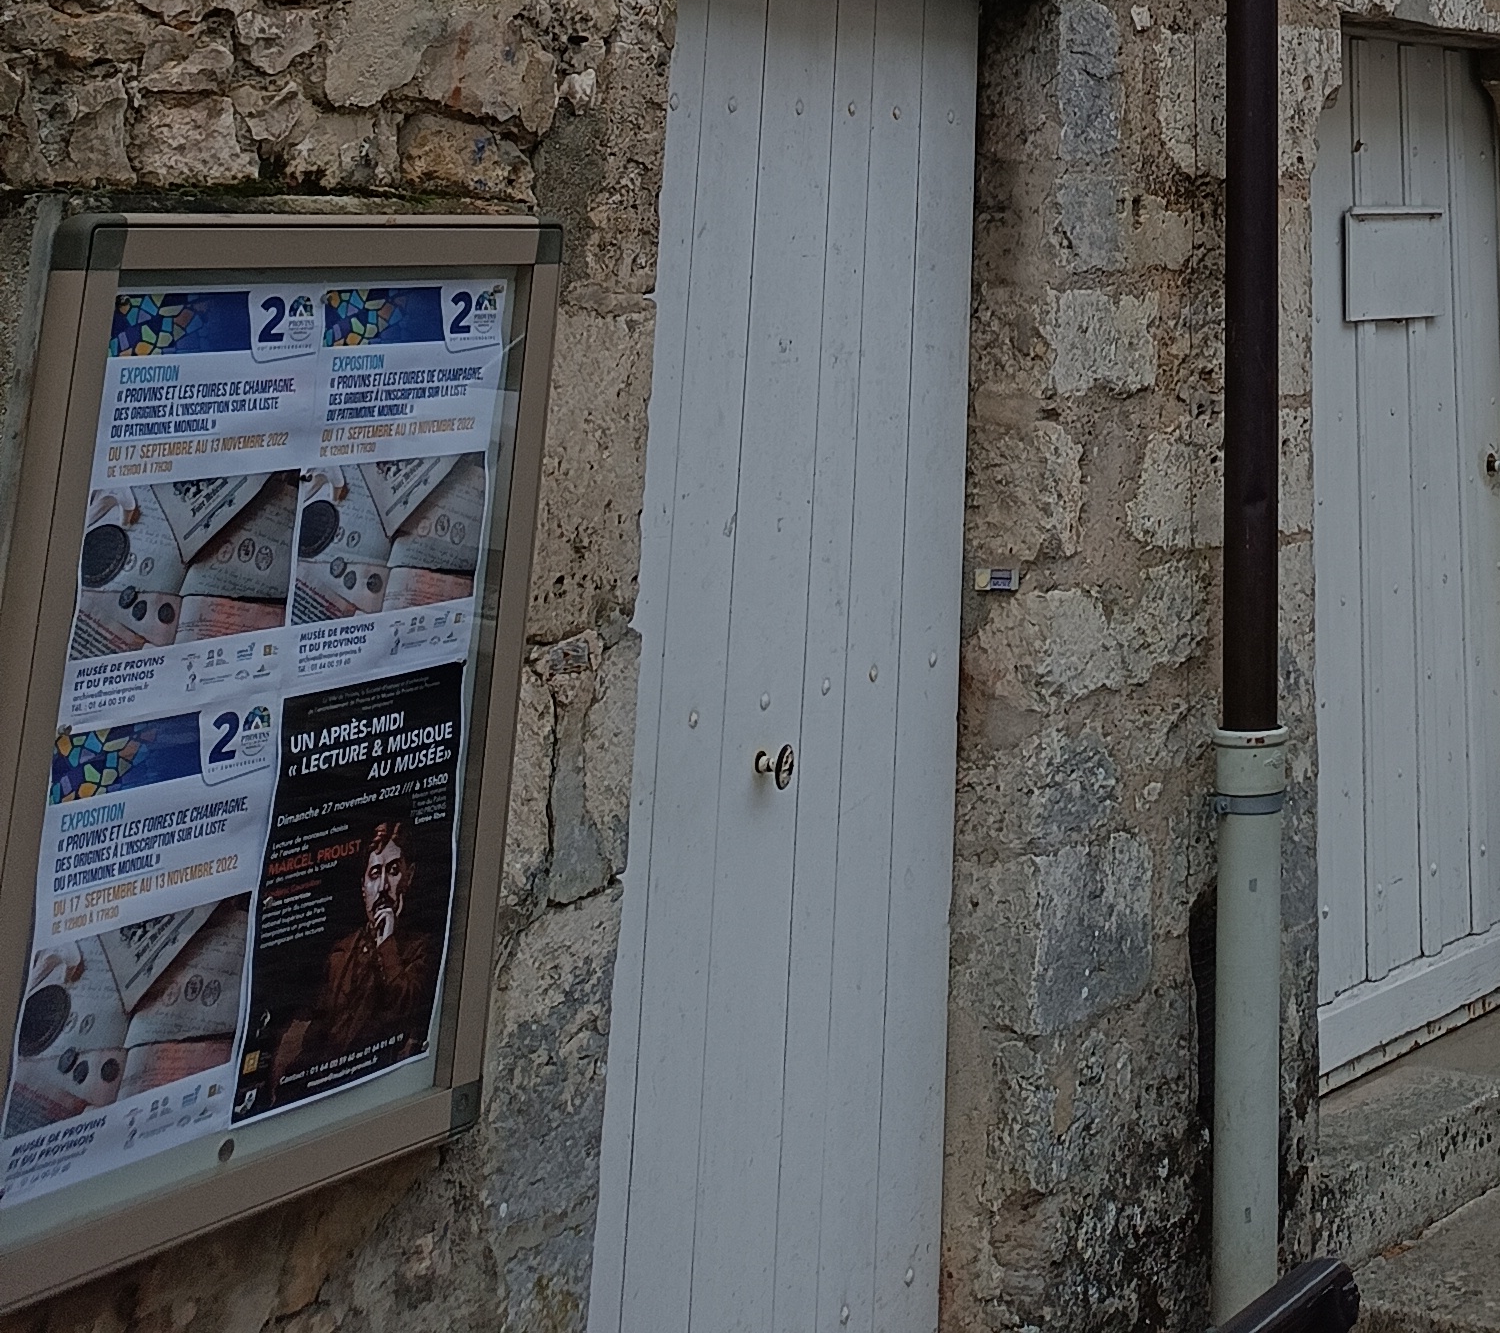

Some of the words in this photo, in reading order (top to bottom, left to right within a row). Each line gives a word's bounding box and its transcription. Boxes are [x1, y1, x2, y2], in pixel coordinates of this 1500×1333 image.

[120, 365, 180, 384] EXPOSITION
[332, 355, 384, 372] EXPOSITION
[337, 374, 371, 389] PROVINS
[372, 373, 384, 386] ET
[386, 372, 397, 386] LES
[399, 370, 425, 385] FOIRES
[427, 370, 436, 383] DE
[437, 367, 483, 382] CHAMPAGNE,
[124, 387, 164, 403] PROVINS
[165, 386, 177, 401] ET
[179, 385, 195, 399] LES
[197, 382, 227, 398] FOIRES
[229, 382, 240, 396] DE
[243, 378, 296, 394] CHAMPAGNE,
[329, 392, 342, 405] DES
[344, 390, 373, 404] ORIGINES
[427, 387, 440, 398] SUR
[441, 386, 449, 397] LA
[450, 384, 468, 396] LISTE
[114, 407, 128, 421] DES
[131, 404, 166, 419] ORIGINES
[231, 400, 245, 412] SUR
[248, 399, 258, 411] LA
[259, 397, 279, 410] LISTE
[327, 409, 336, 421] DU
[337, 406, 375, 421] PATRIMOINE
[378, 404, 408, 417] MONDIAL
[111, 425, 123, 438] DU
[124, 421, 172, 437] PATRIMOINE
[174, 419, 209, 433] MONDIAL
[322, 429, 332, 442] DU
[335, 428, 344, 441] 17
[347, 423, 393, 439] SEPTEMBRE
[395, 422, 405, 436] AU
[409, 422, 416, 435] 13
[418, 419, 456, 434] NOVEMBRE
[457, 417, 475, 431] 2022
[109, 447, 121, 461] DU
[125, 446, 136, 460] 17
[140, 441, 192, 459] SEPTEMBRE
[195, 440, 207, 453] AU
[211, 439, 219, 452] 13
[221, 435, 265, 451] NOVEMBRE
[267, 432, 289, 446] 2022
[300, 627, 325, 642] MUSÉE
[327, 627, 338, 637] DE
[339, 622, 375, 635] PROVINS
[299, 644, 307, 654] ET
[309, 642, 320, 652] DU
[322, 635, 366, 649] PROVINOIS
[76, 662, 108, 678] MUSÉE
[110, 661, 122, 672] DE
[123, 656, 165, 671] PROVINS
[74, 681, 85, 691] ET
[86, 677, 99, 688] DU
[102, 670, 154, 686] PROVINOIS
[291, 732, 314, 753] UN
[319, 711, 405, 747] APRÈS-MIDI
[301, 742, 369, 774] LECTURE
[372, 739, 383, 756] &
[387, 721, 452, 753] MUSIQUE
[367, 760, 391, 780] AU
[61, 802, 125, 832] EXPOSITION
[277, 806, 319, 827] Dimanche
[321, 802, 332, 815] 27
[334, 791, 377, 811] novembre
[378, 785, 400, 800] 2022
[66, 830, 107, 852] PROVINS
[109, 825, 122, 841] ET
[124, 821, 140, 839] LES
[142, 814, 175, 835] FOIRES
[176, 812, 188, 828] DE
[190, 796, 248, 822] CHAMPAGNE,
[55, 858, 71, 873] DES
[74, 849, 111, 870] ORIGINES
[177, 828, 192, 843] SUR
[193, 824, 204, 839] LA
[205, 819, 228, 836] LISTE
[268, 853, 314, 875] MARCEL
[317, 839, 361, 861] PROUST
[54, 878, 65, 892] DU
[66, 866, 116, 890] PATRIMOINE
[118, 859, 153, 875] MONDIAL
[54, 900, 66, 917] DU
[69, 897, 80, 913] 17
[85, 881, 138, 908] SEPTEMBRE
[140, 878, 151, 894] AU
[156, 874, 164, 889] 13
[167, 859, 214, 885] NOVEMBRE
[216, 854, 238, 873] 2022
